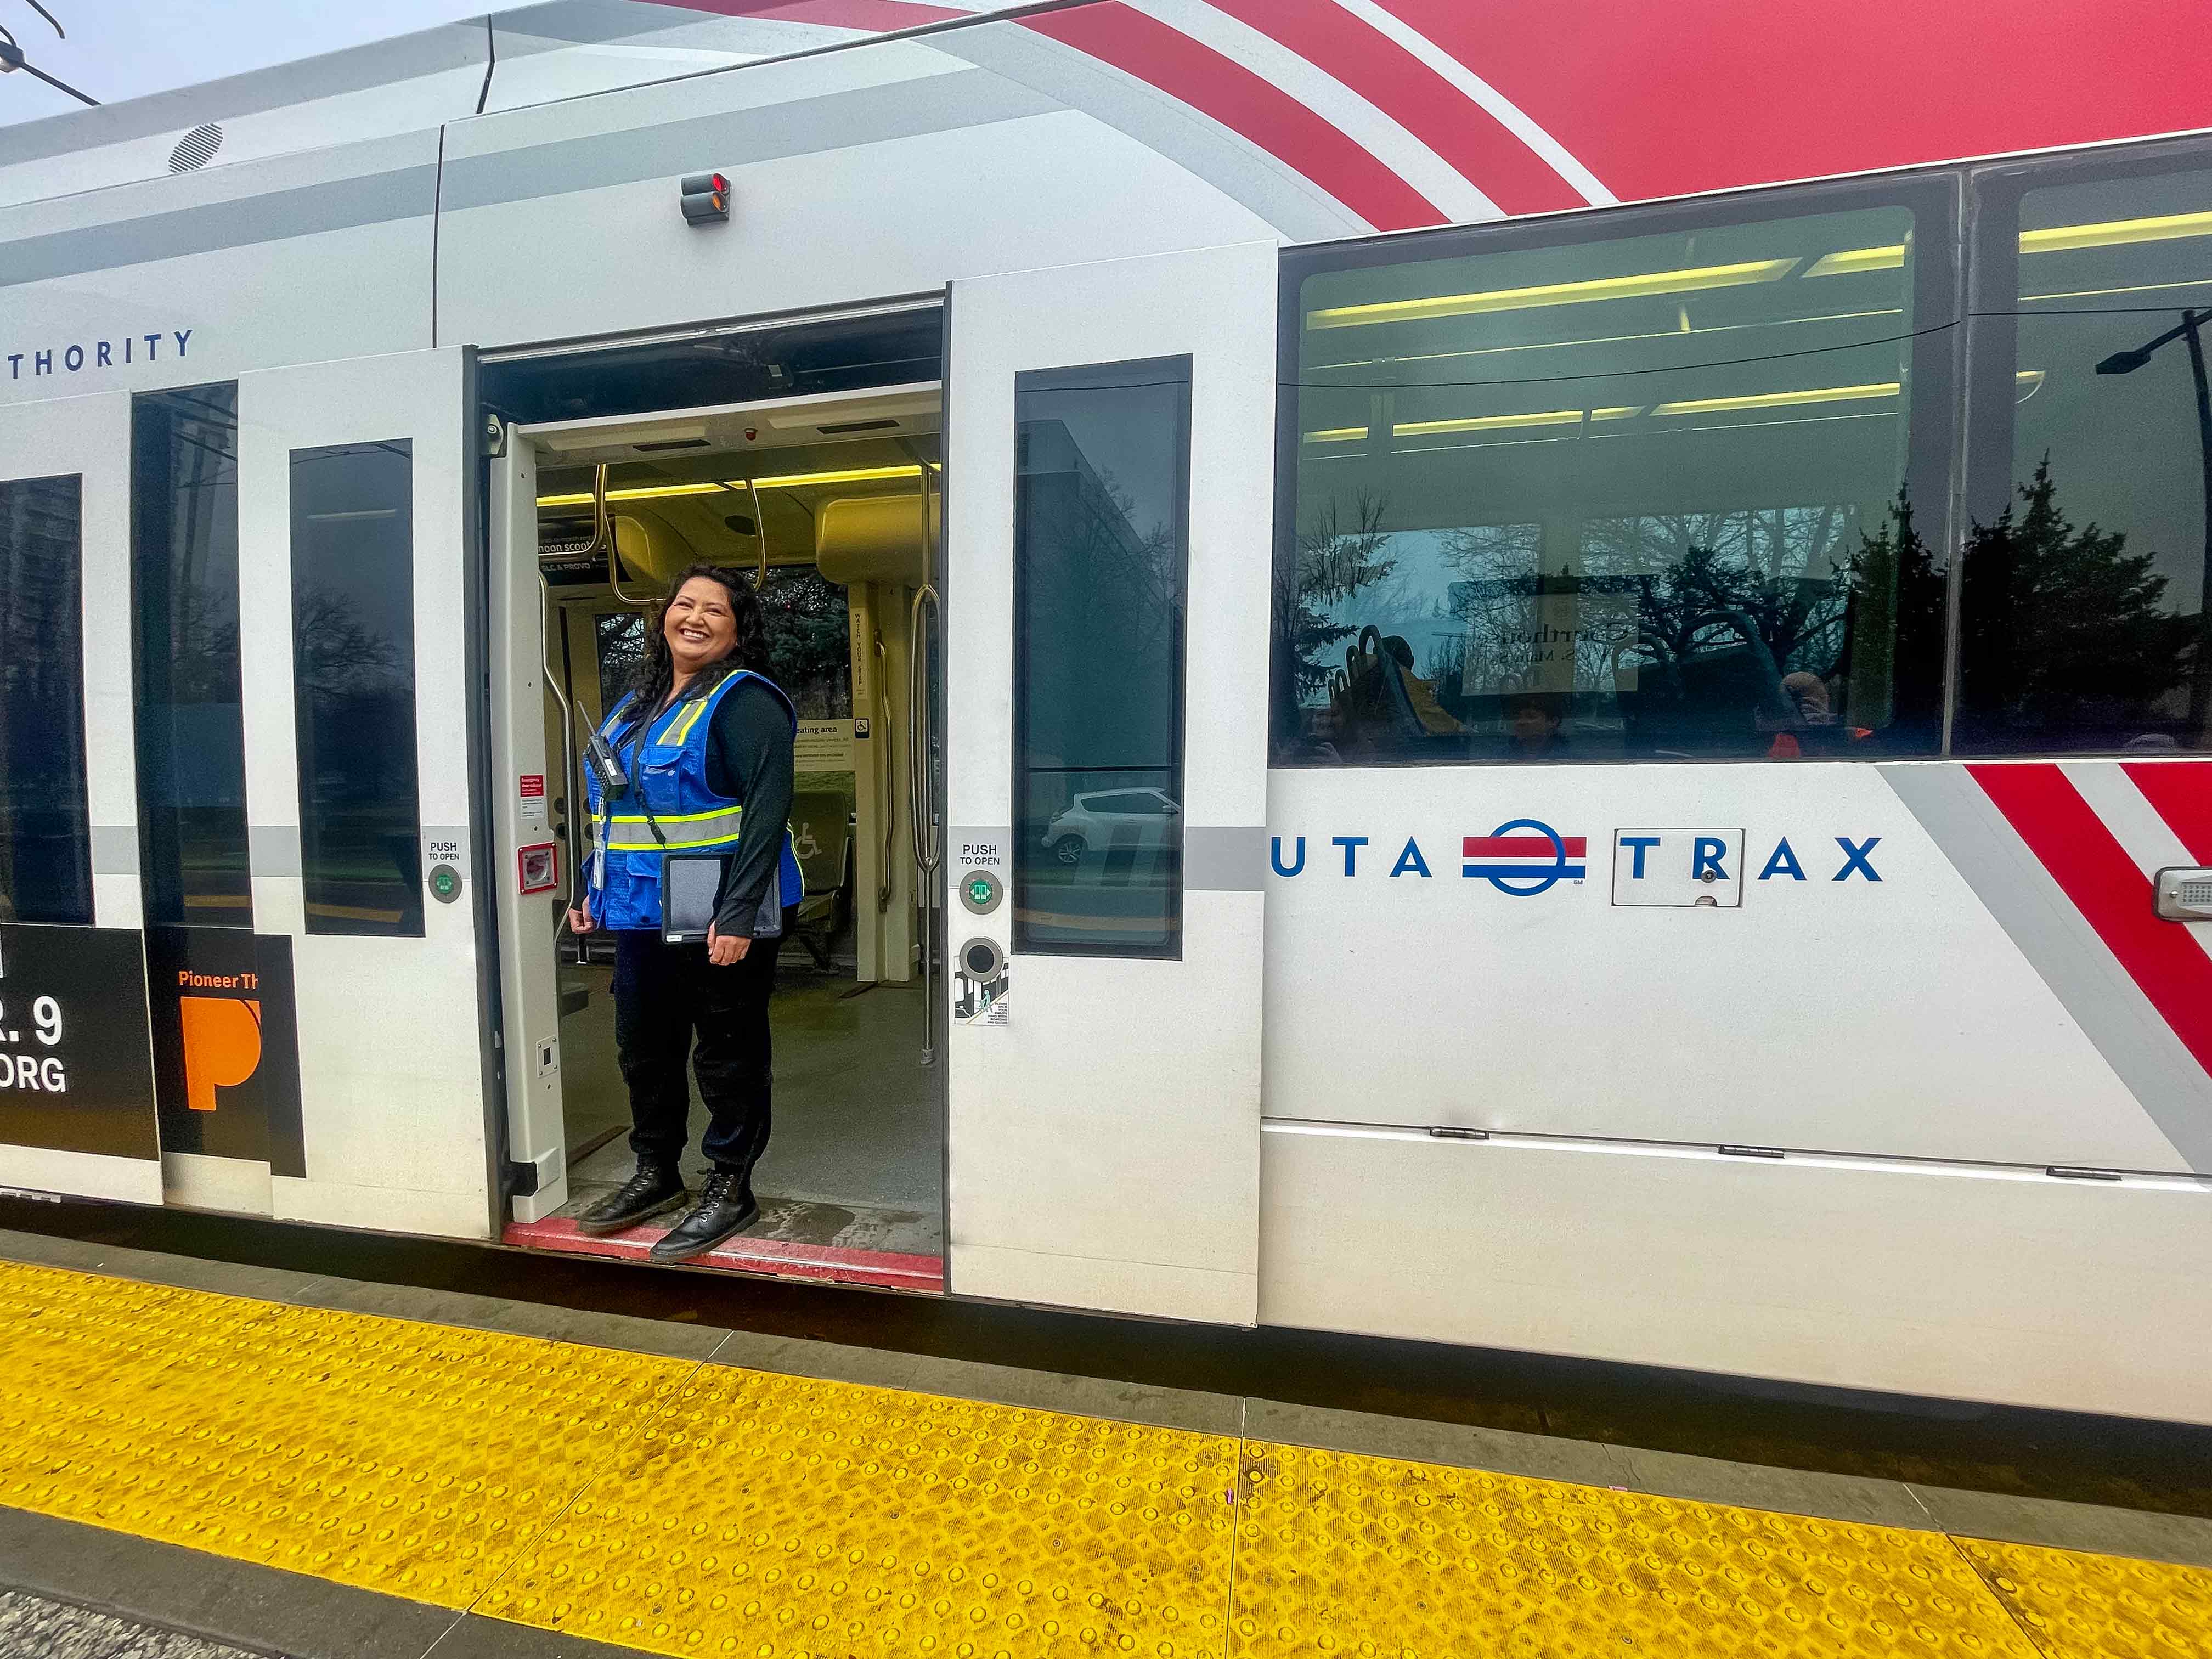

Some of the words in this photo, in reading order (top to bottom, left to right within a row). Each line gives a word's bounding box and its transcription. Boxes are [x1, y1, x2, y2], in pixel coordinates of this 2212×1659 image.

[7, 329, 193, 380] THORITY
[430, 842, 457, 851] PUSH
[963, 844, 997, 855] PUSH
[974, 857, 1000, 865] OPEN
[1271, 836, 1433, 878] UTA
[1619, 836, 1883, 882] TRAX
[179, 970, 239, 988] Pioneer
[33, 995, 64, 1046] 9
